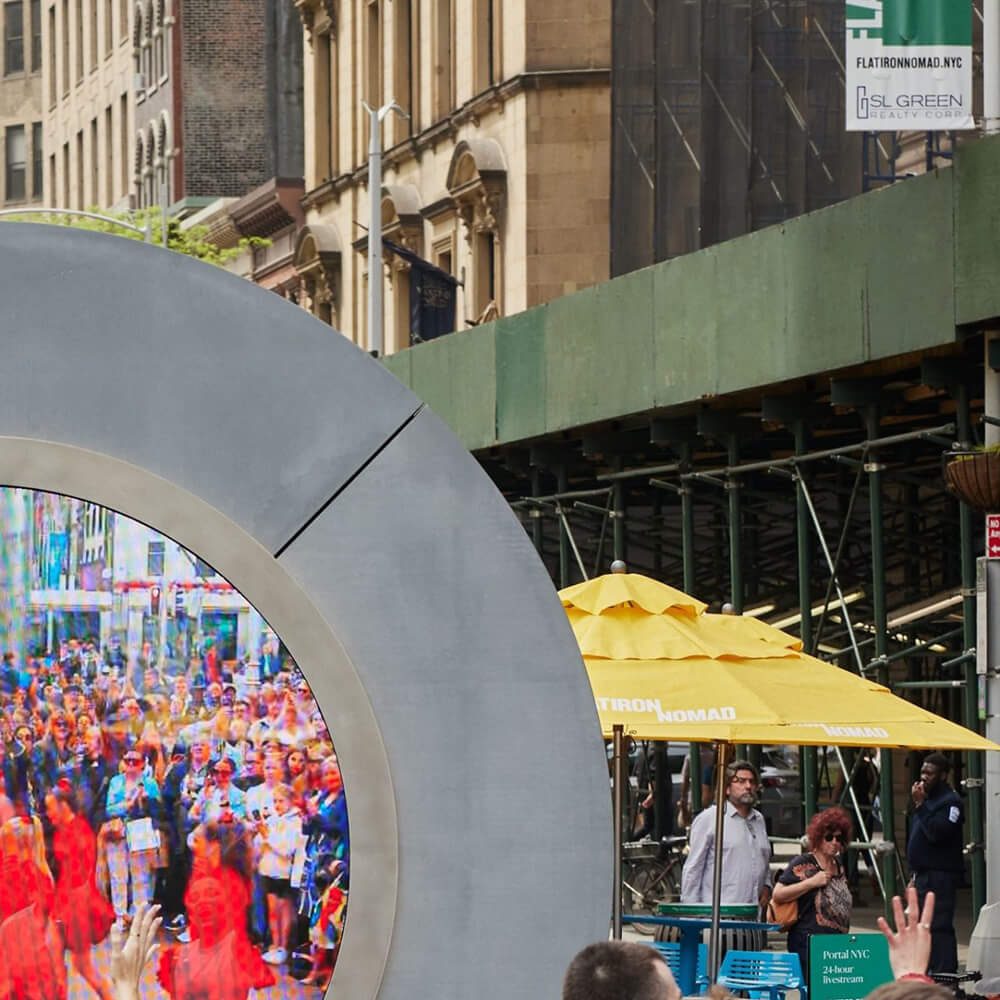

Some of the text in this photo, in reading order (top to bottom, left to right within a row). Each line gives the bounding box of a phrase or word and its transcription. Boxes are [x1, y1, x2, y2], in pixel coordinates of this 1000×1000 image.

[856, 56, 962, 69] FLATIRONNOMAD.NYC
[870, 94, 963, 108] SL GREEN
[870, 110, 917, 119] REALTY
[597, 696, 737, 723] TIRON NOMAD
[823, 949, 870, 959] Portal NYC
[823, 965, 854, 974] 24-hour
[823, 975, 864, 984] livestream
